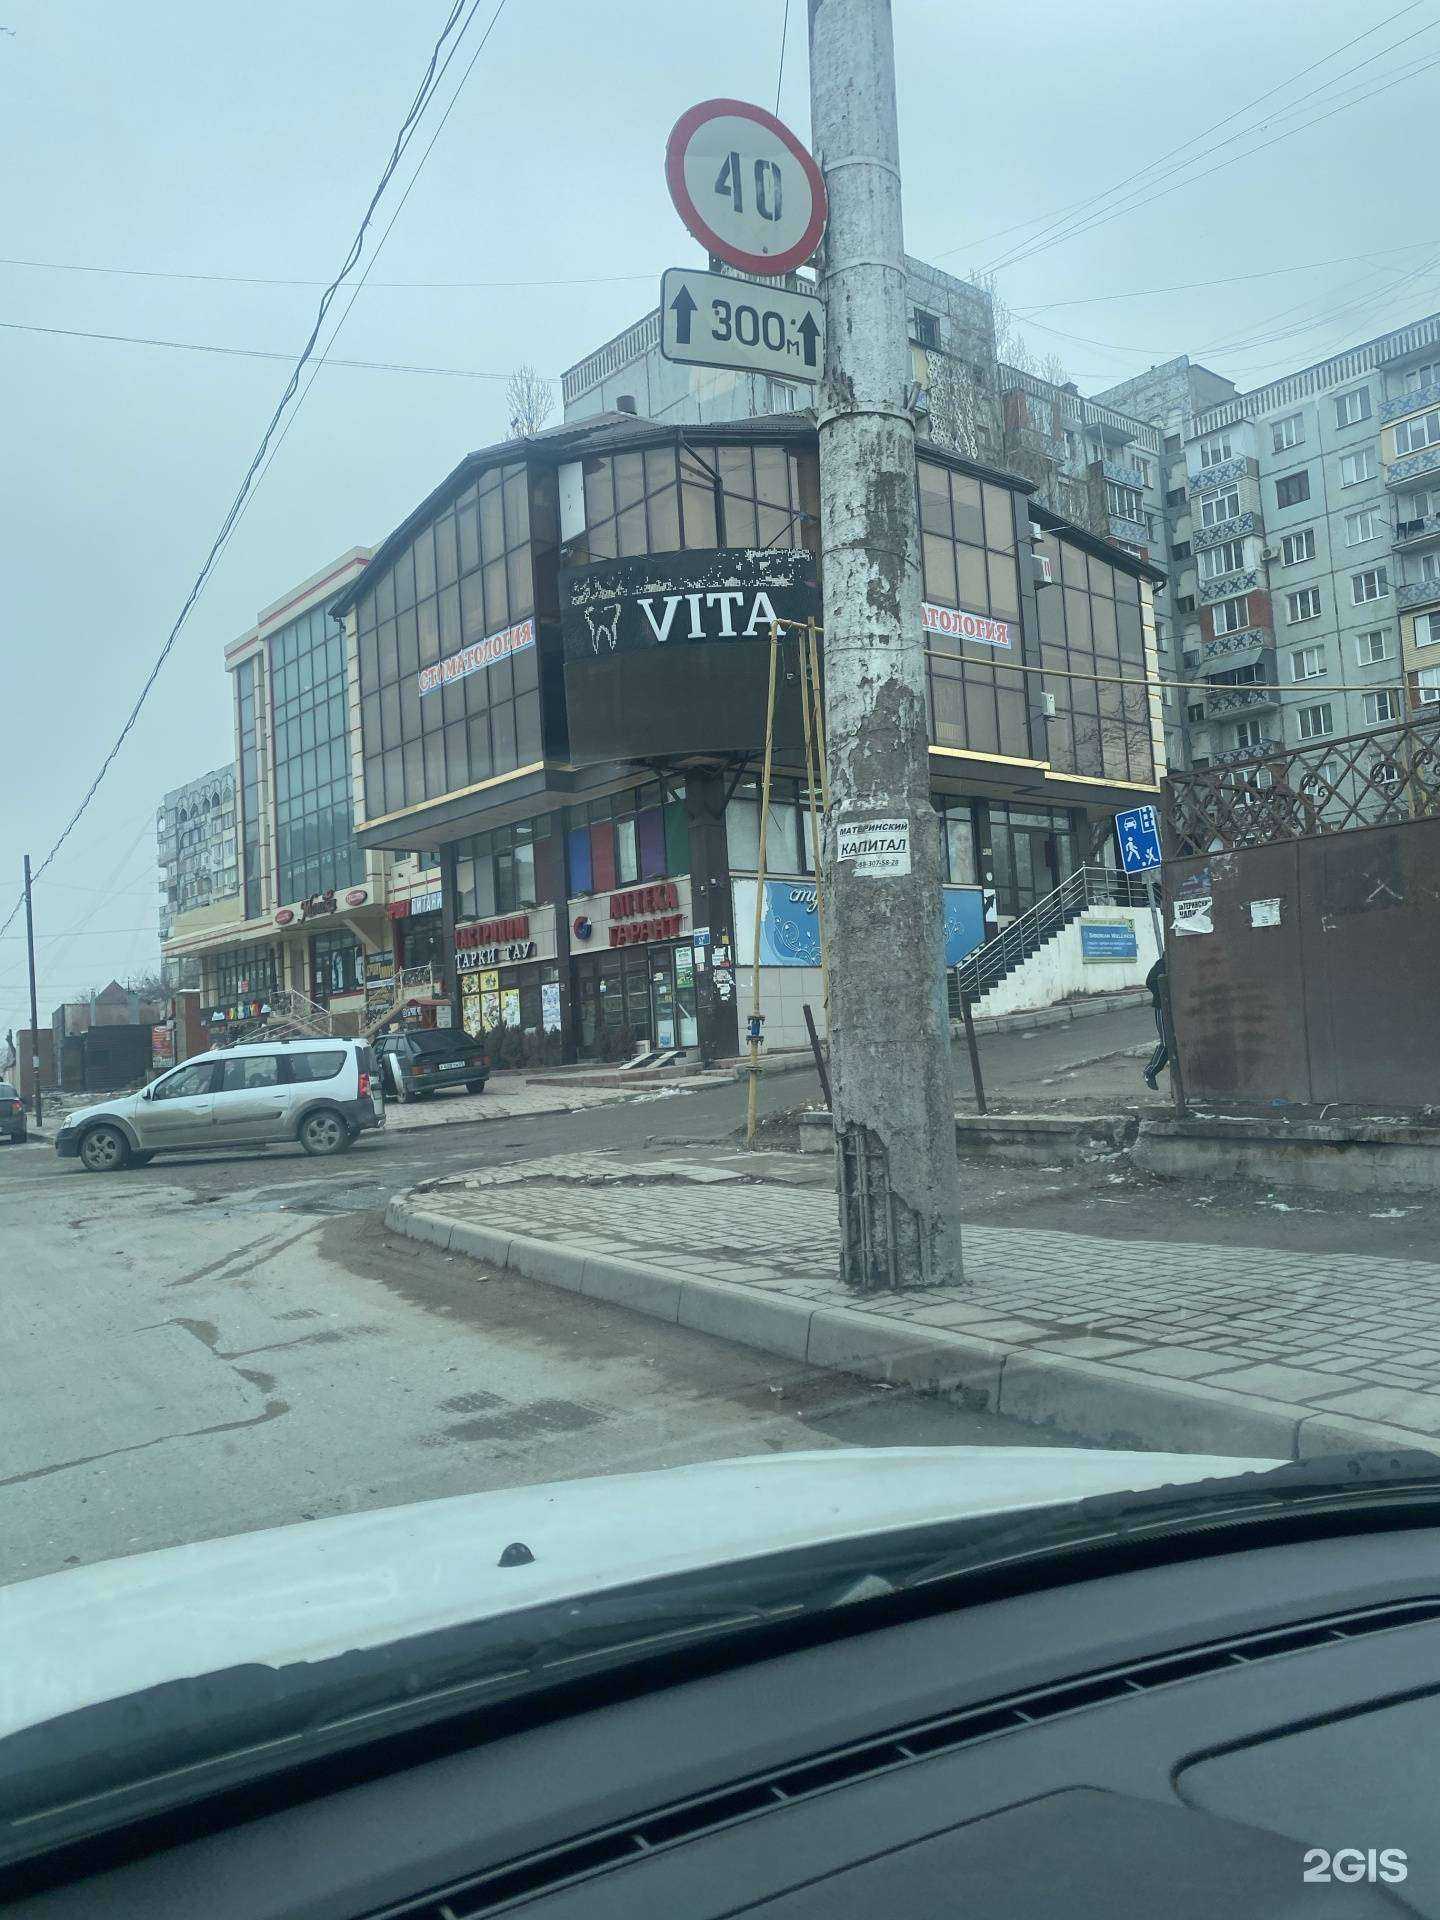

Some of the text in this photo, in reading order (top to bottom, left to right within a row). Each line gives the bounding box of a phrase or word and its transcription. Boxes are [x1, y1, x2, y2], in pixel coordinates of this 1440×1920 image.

[714, 151, 783, 222] 40
[637, 591, 787, 643] VITA
[419, 621, 533, 691] СТОМАТОЛОГИЯ
[841, 839, 907, 856] КАПИТАЛ
[455, 941, 531, 969] ТАРКИ ТАУ
